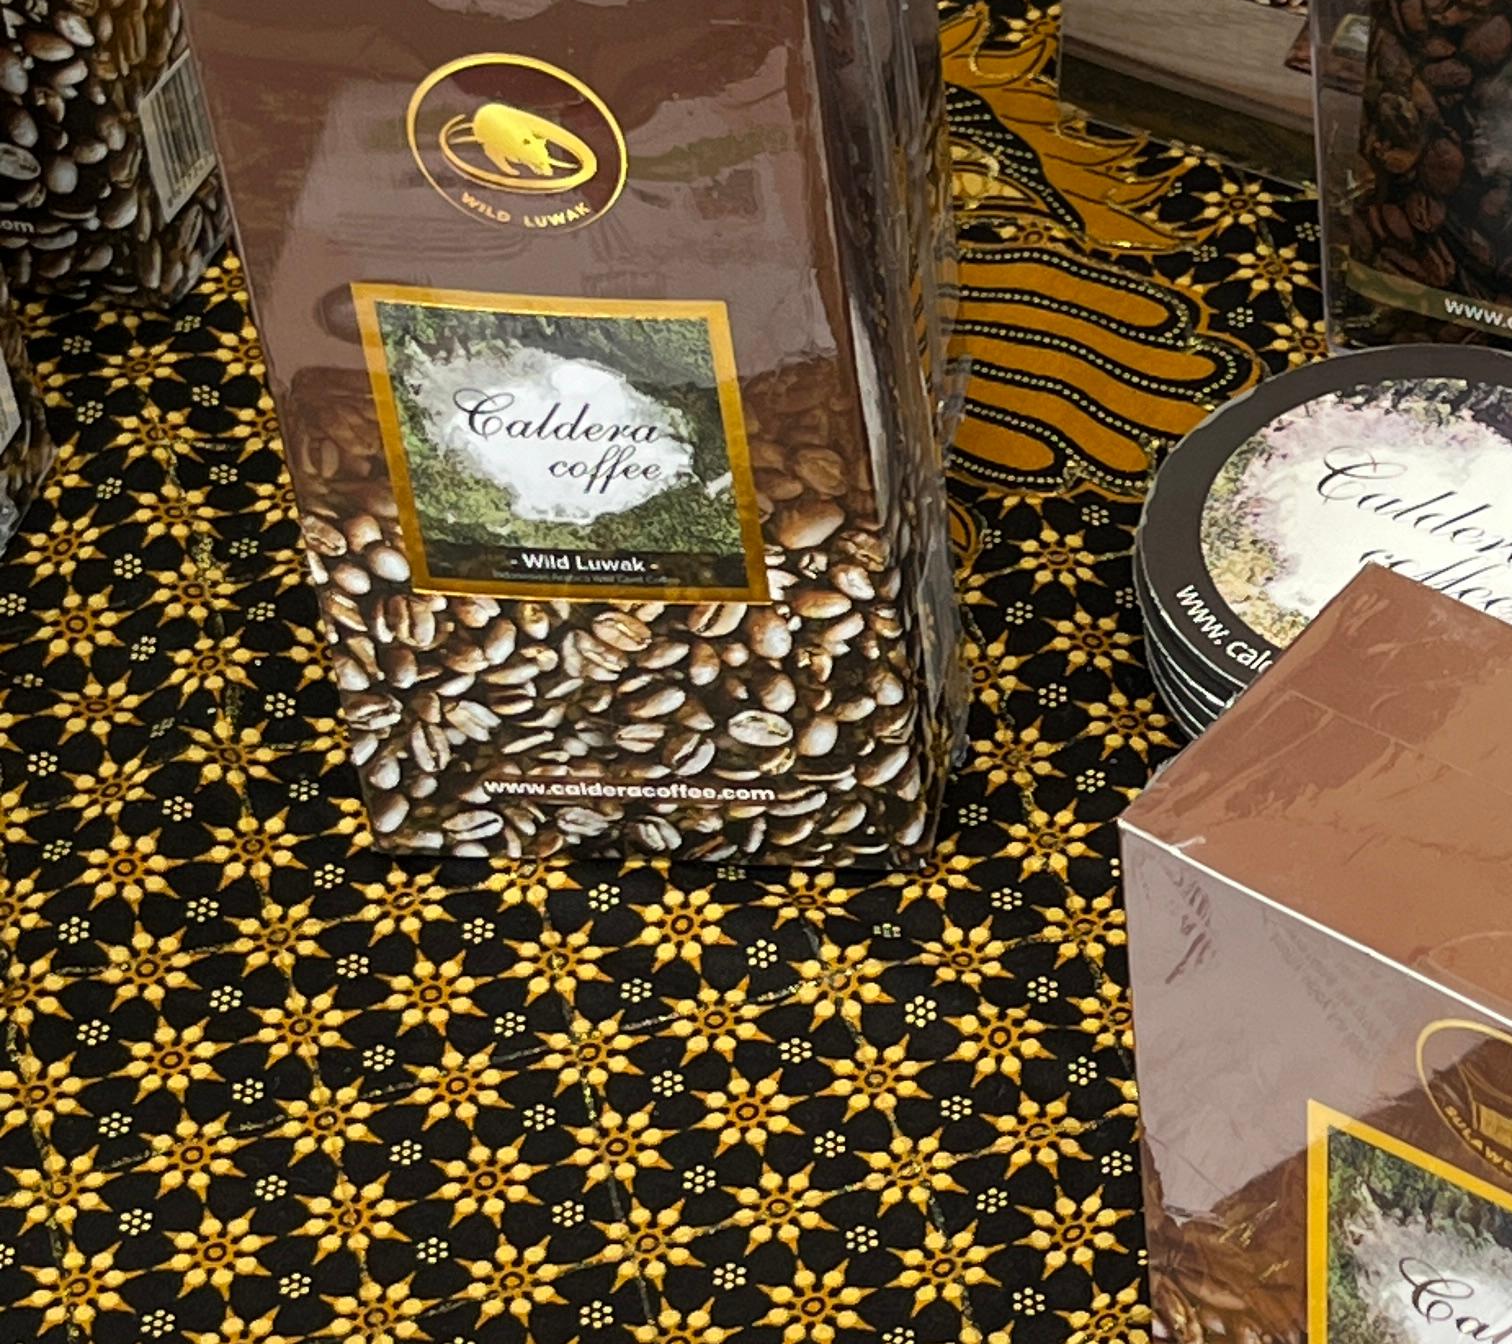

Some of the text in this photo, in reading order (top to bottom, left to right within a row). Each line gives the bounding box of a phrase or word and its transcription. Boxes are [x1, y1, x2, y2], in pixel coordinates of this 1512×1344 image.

[462, 192, 591, 228] WILD LUWAK
[453, 387, 658, 443] Caldera
[549, 444, 661, 494] coffee
[522, 554, 646, 572] Wild Luwak
[483, 781, 776, 801] www.calderacoffee.com
